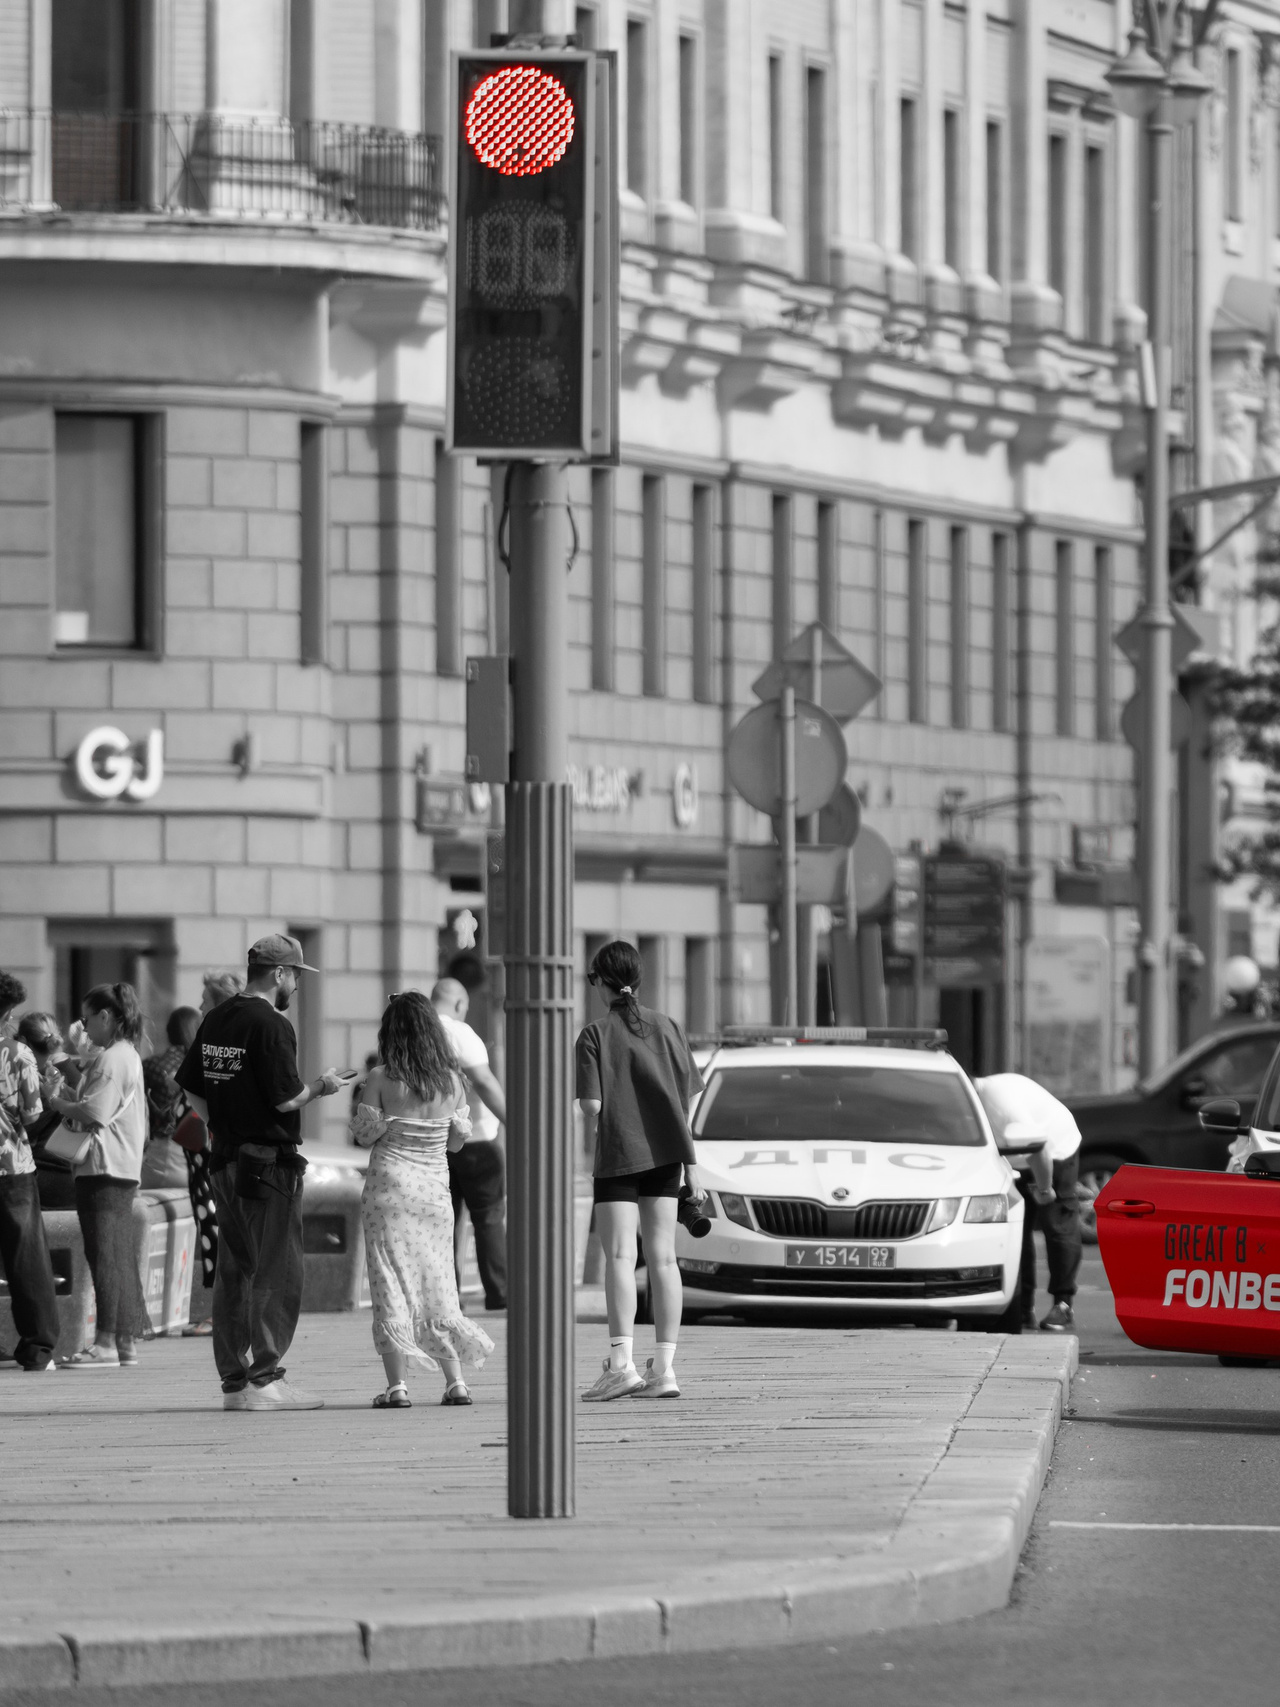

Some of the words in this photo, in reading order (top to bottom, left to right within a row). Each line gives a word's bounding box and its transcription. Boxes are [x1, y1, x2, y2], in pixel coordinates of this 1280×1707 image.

[77, 725, 164, 799] GJ
[728, 1149, 947, 1171] ДПС
[815, 1246, 860, 1266] 1514
[870, 1247, 889, 1261] 99
[1165, 1223, 1228, 1262] GREAT
[1235, 1226, 1248, 1263] 8
